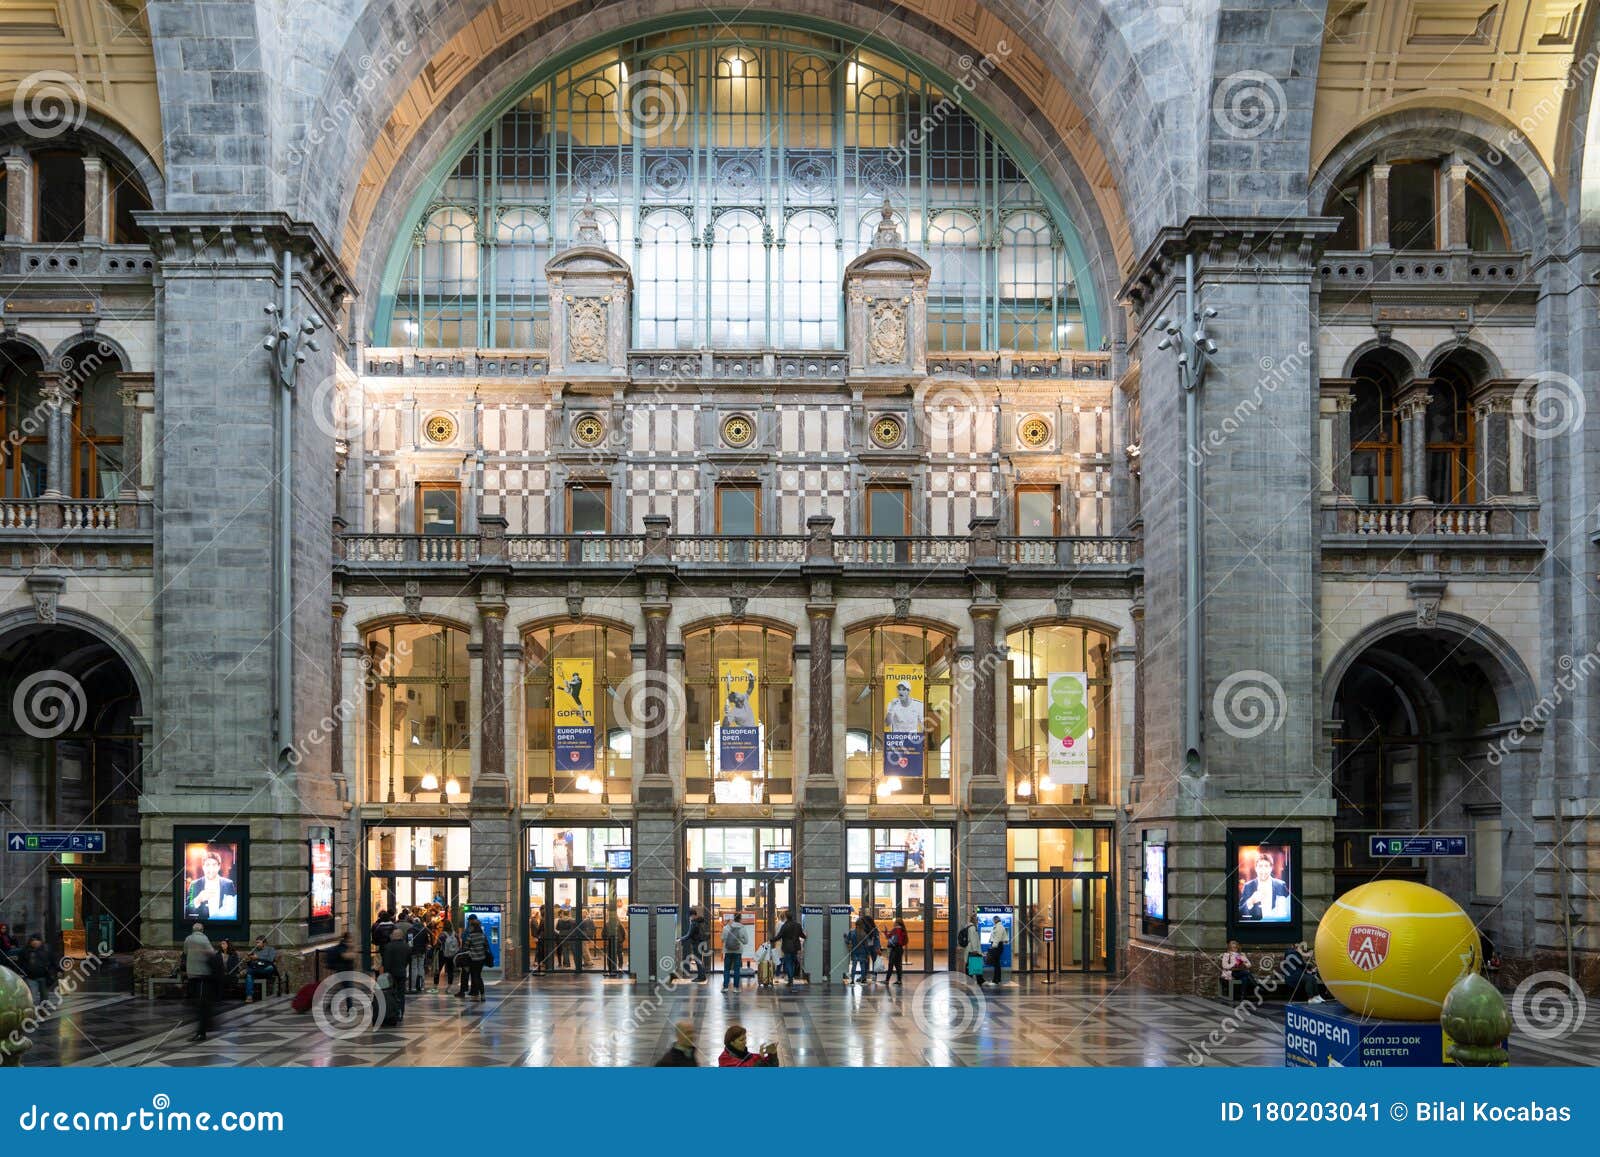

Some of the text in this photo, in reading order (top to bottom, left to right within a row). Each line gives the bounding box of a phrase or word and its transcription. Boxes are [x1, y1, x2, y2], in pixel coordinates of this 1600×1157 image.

[1353, 927, 1388, 939] SPORTING
[1287, 1011, 1350, 1046] EUROPEAN
[1287, 1032, 1317, 1057] OPEN
[1363, 1036, 1421, 1045] KOM JIJ OOK
[1363, 1048, 1409, 1056] GENIETEN
